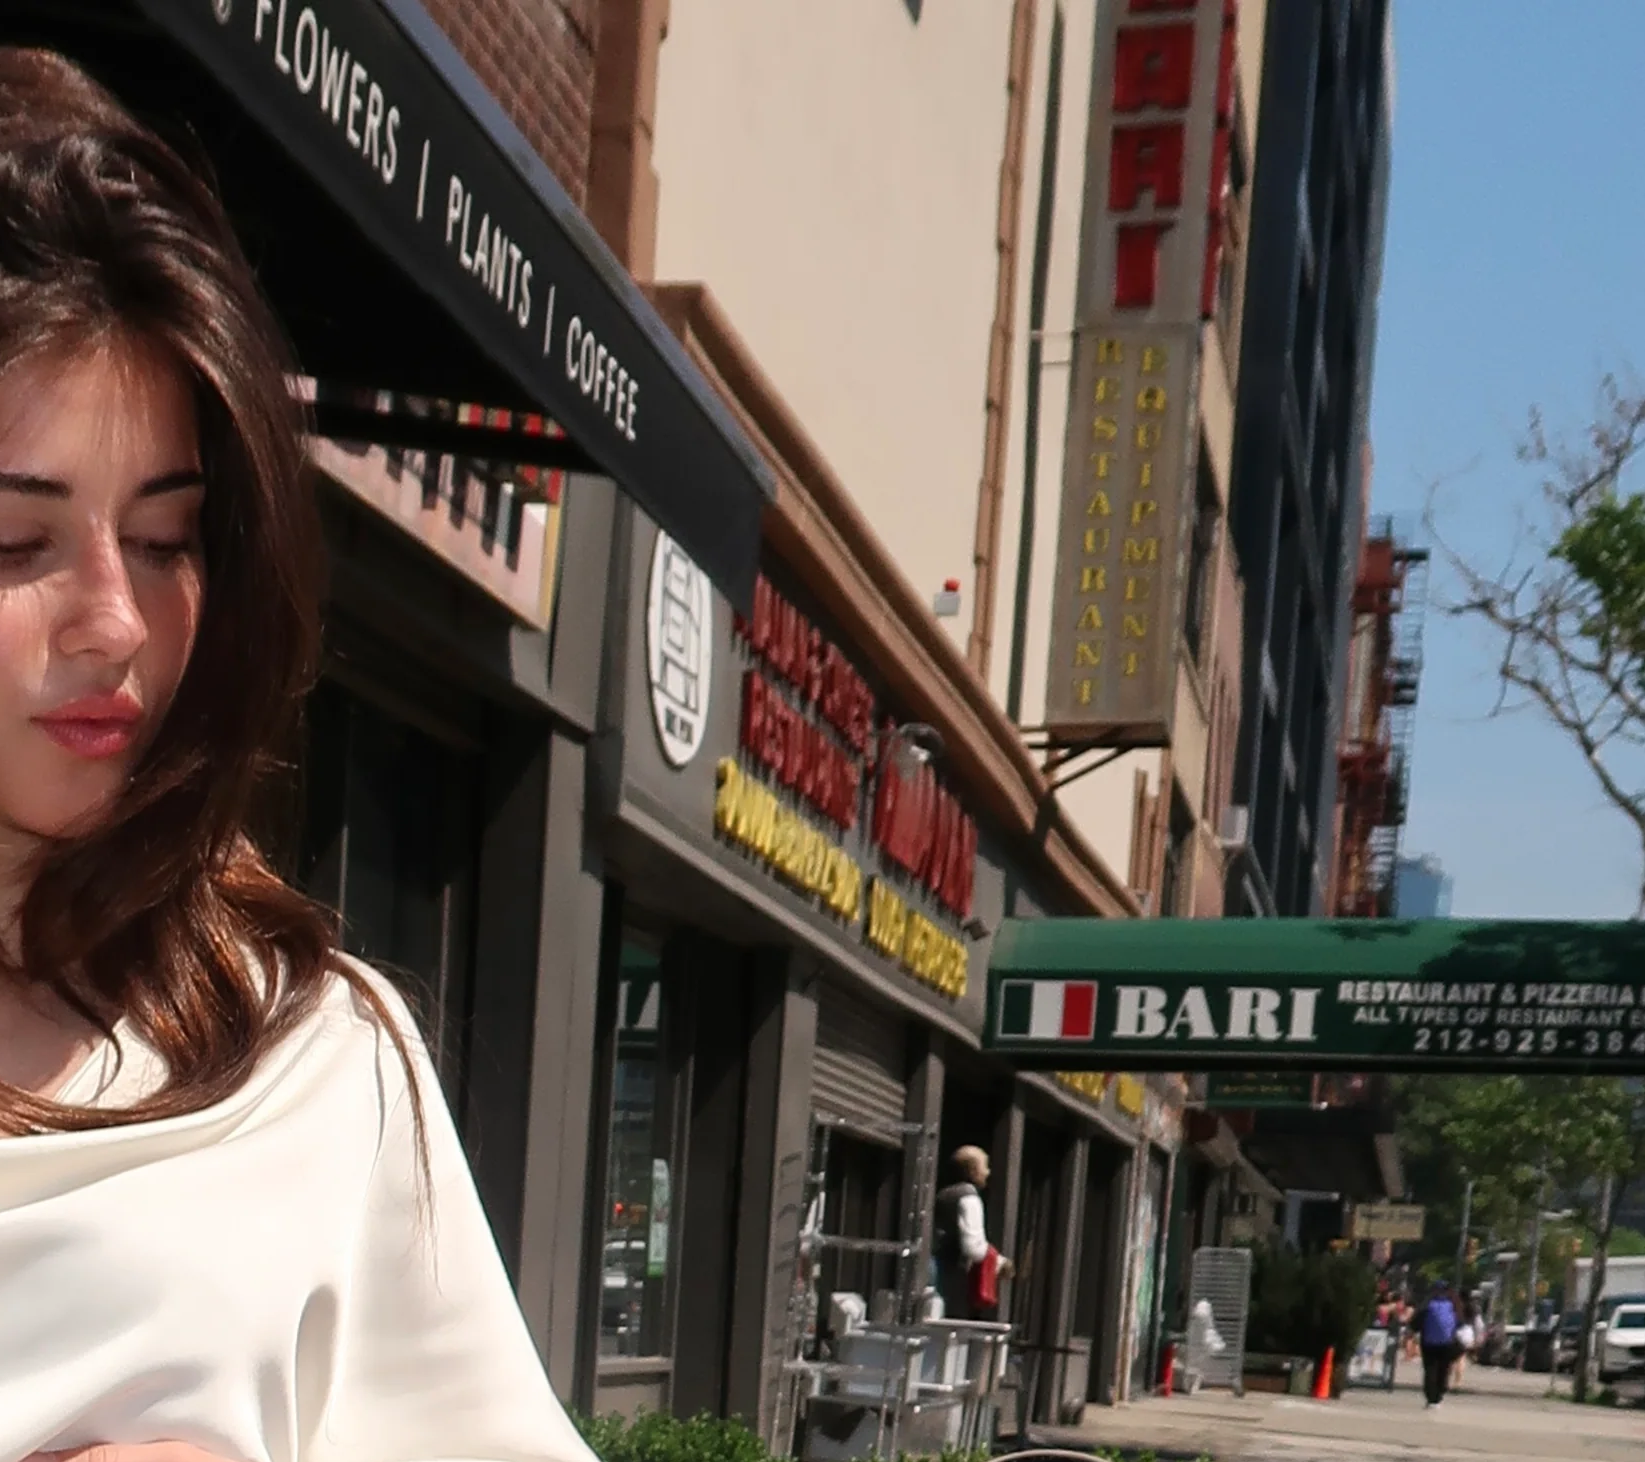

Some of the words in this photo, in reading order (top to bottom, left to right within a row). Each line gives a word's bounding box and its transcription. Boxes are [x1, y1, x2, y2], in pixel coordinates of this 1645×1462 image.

[253, 0, 402, 186] FLOWERS
[445, 173, 534, 330] PLANTS
[564, 314, 640, 442] COFFEE
[1111, 985, 1323, 1042] BARI
[1337, 980, 1496, 1004] RESTAURANT
[1500, 983, 1517, 1004] &
[1522, 983, 1635, 1006] PIZZERIA
[1353, 1006, 1391, 1024] ALL
[1397, 1006, 1460, 1025] TYPES
[1464, 1007, 1490, 1025] OF
[1495, 1007, 1626, 1027] RESTAURANT
